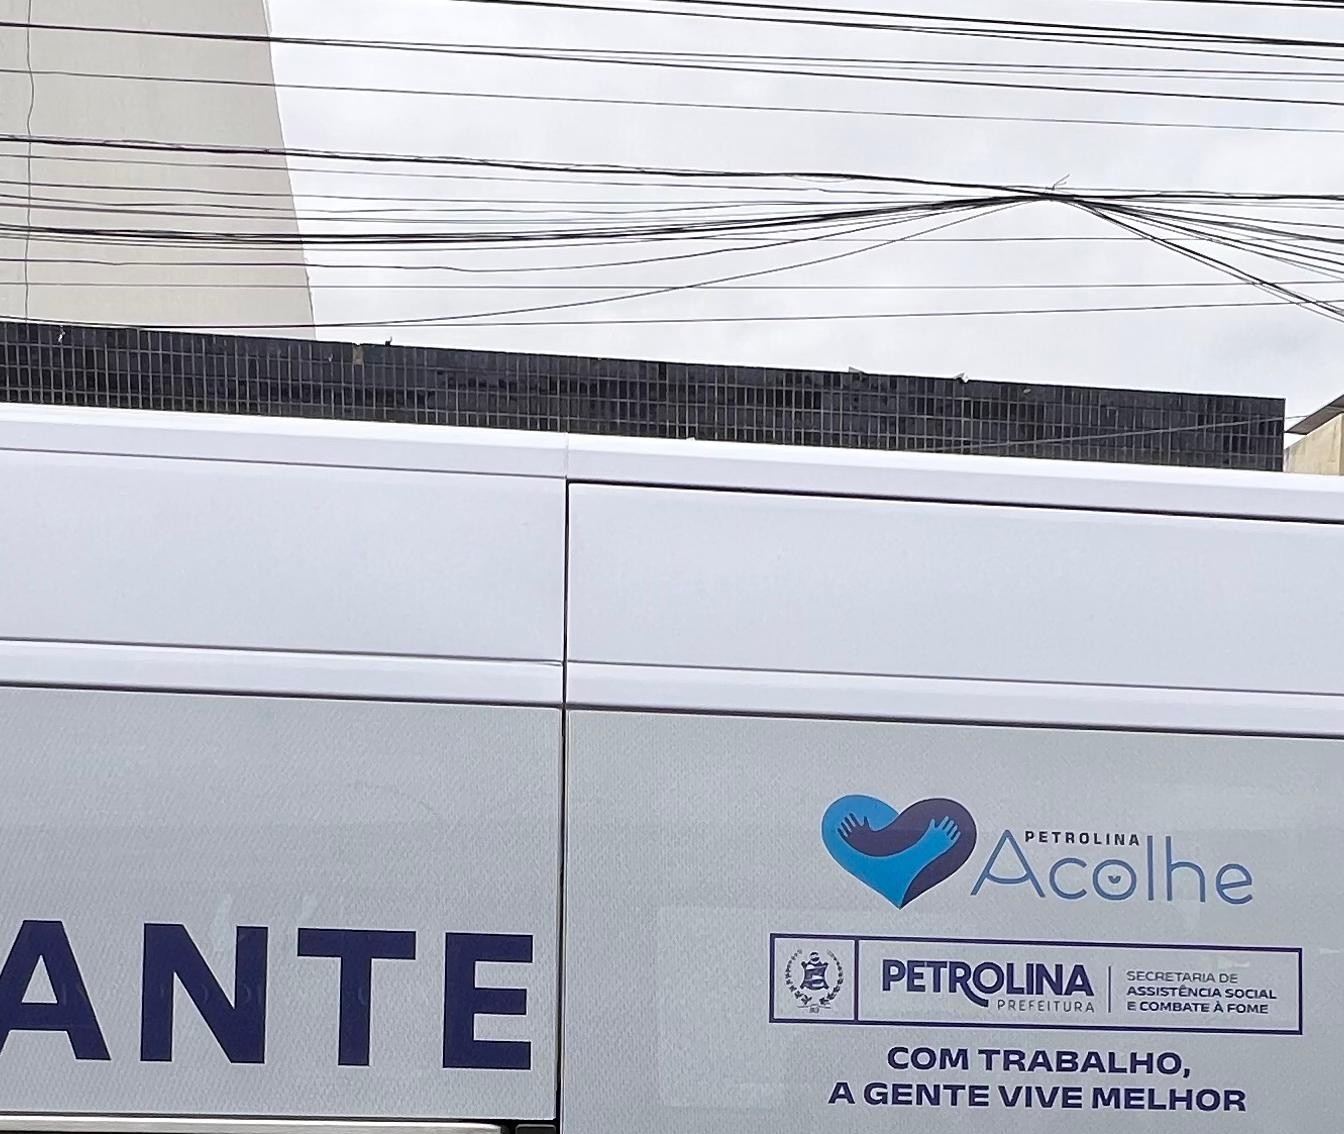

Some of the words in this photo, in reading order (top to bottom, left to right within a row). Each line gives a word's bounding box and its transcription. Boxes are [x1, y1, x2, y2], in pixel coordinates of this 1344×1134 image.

[1024, 830, 1140, 847] PETROLINA
[970, 829, 1253, 905] Acolhe
[882, 959, 1095, 1008] PETROLINA
[1126, 970, 1216, 983] SECRETARIA
[1219, 972, 1239, 984] DE
[1126, 984, 1223, 998] ASSISTÊNCIA
[1224, 988, 1278, 1000] SOCIAL
[997, 999, 1095, 1014] PREFEITURA
[1127, 1001, 1137, 1011] E
[1139, 1001, 1210, 1013] COMBATE
[1213, 1000, 1224, 1013] À
[1227, 1003, 1269, 1014] FOME
[886, 1045, 969, 1071] COM
[977, 1048, 1191, 1079] TRABALHO,
[827, 1081, 856, 1105] A
[863, 1082, 990, 1108] GENTE
[998, 1085, 1084, 1110] VIVE
[1091, 1087, 1247, 1112] MELHOR
